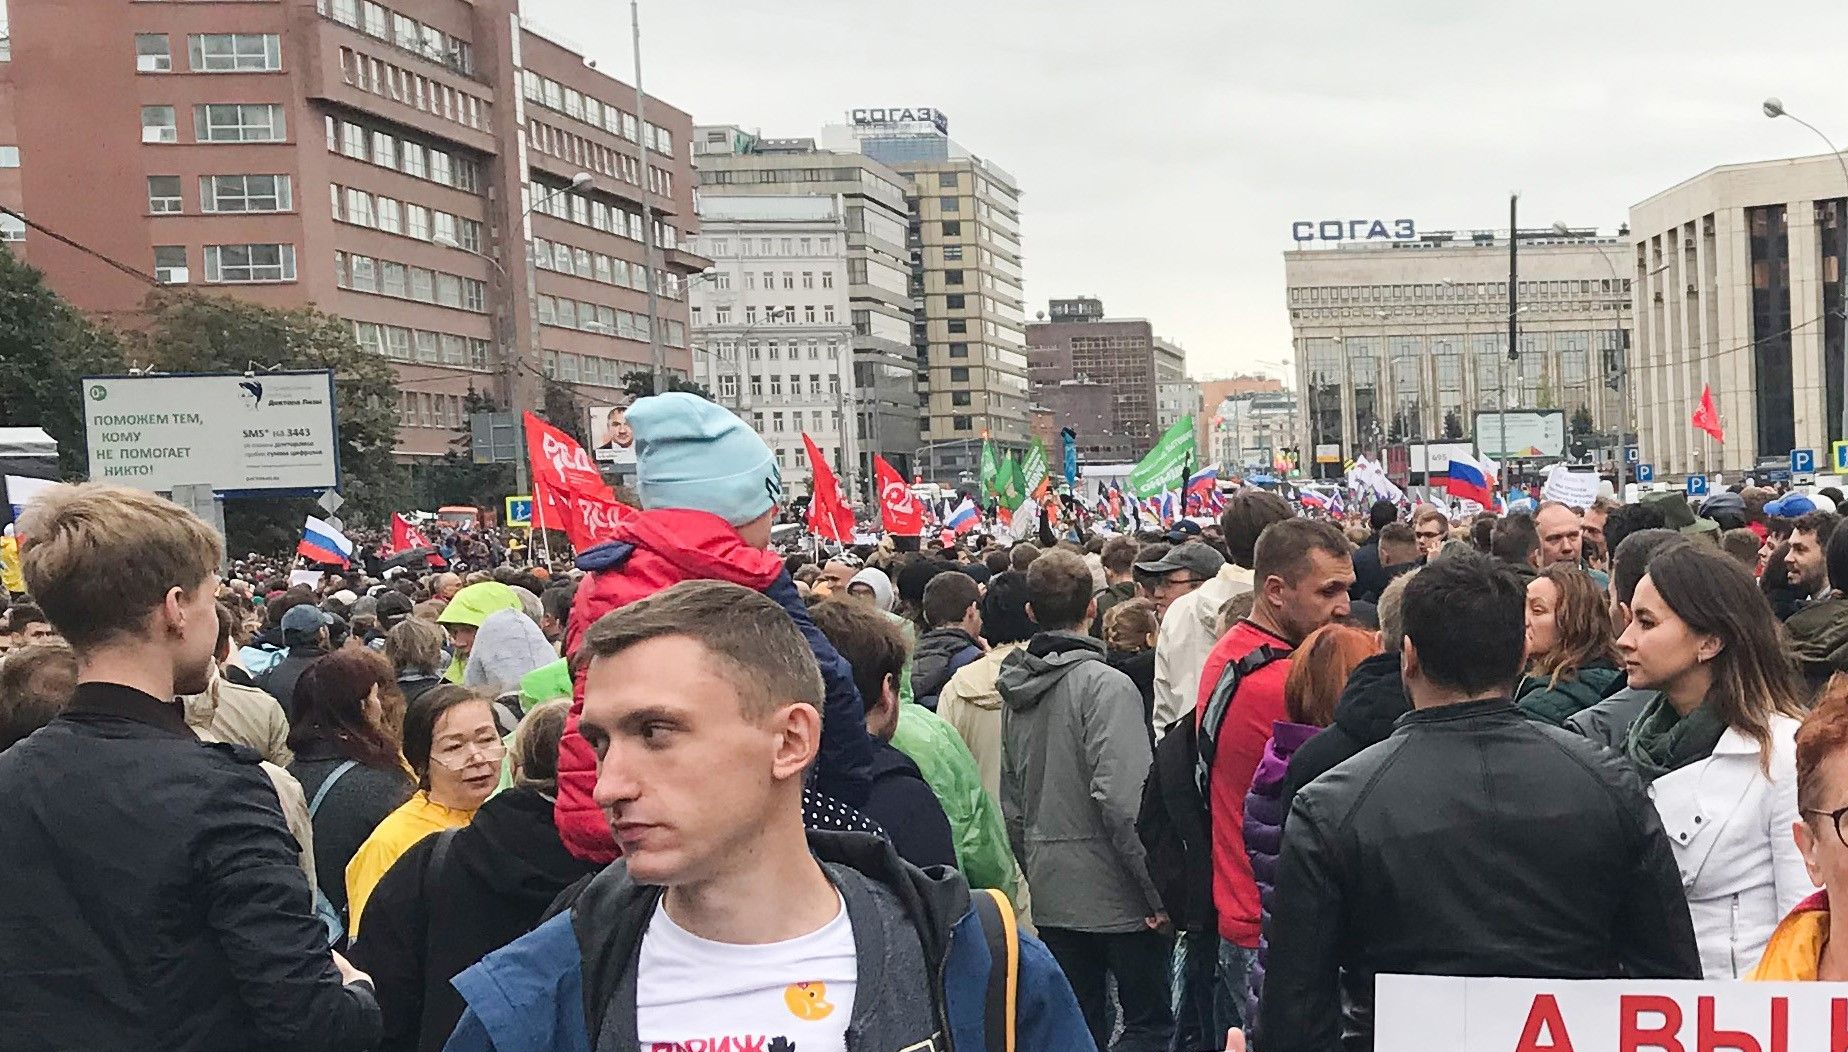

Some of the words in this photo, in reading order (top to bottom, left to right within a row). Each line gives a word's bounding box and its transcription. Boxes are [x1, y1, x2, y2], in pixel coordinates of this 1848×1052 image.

[852, 108, 931, 122] СОГАЗ
[1293, 219, 1415, 240] СОГАЗ
[94, 414, 169, 426] ПОМОЖЕМ
[172, 413, 204, 425] ТЕМ,
[102, 431, 141, 443] КОМУ
[287, 428, 311, 437] 3443
[96, 449, 113, 460] НЕ
[120, 447, 191, 459] ПОМОГАЕТ
[1796, 452, 1809, 469] P
[104, 465, 154, 477] НИКТО!
[1640, 465, 1650, 481] P
[1691, 477, 1702, 493] P
